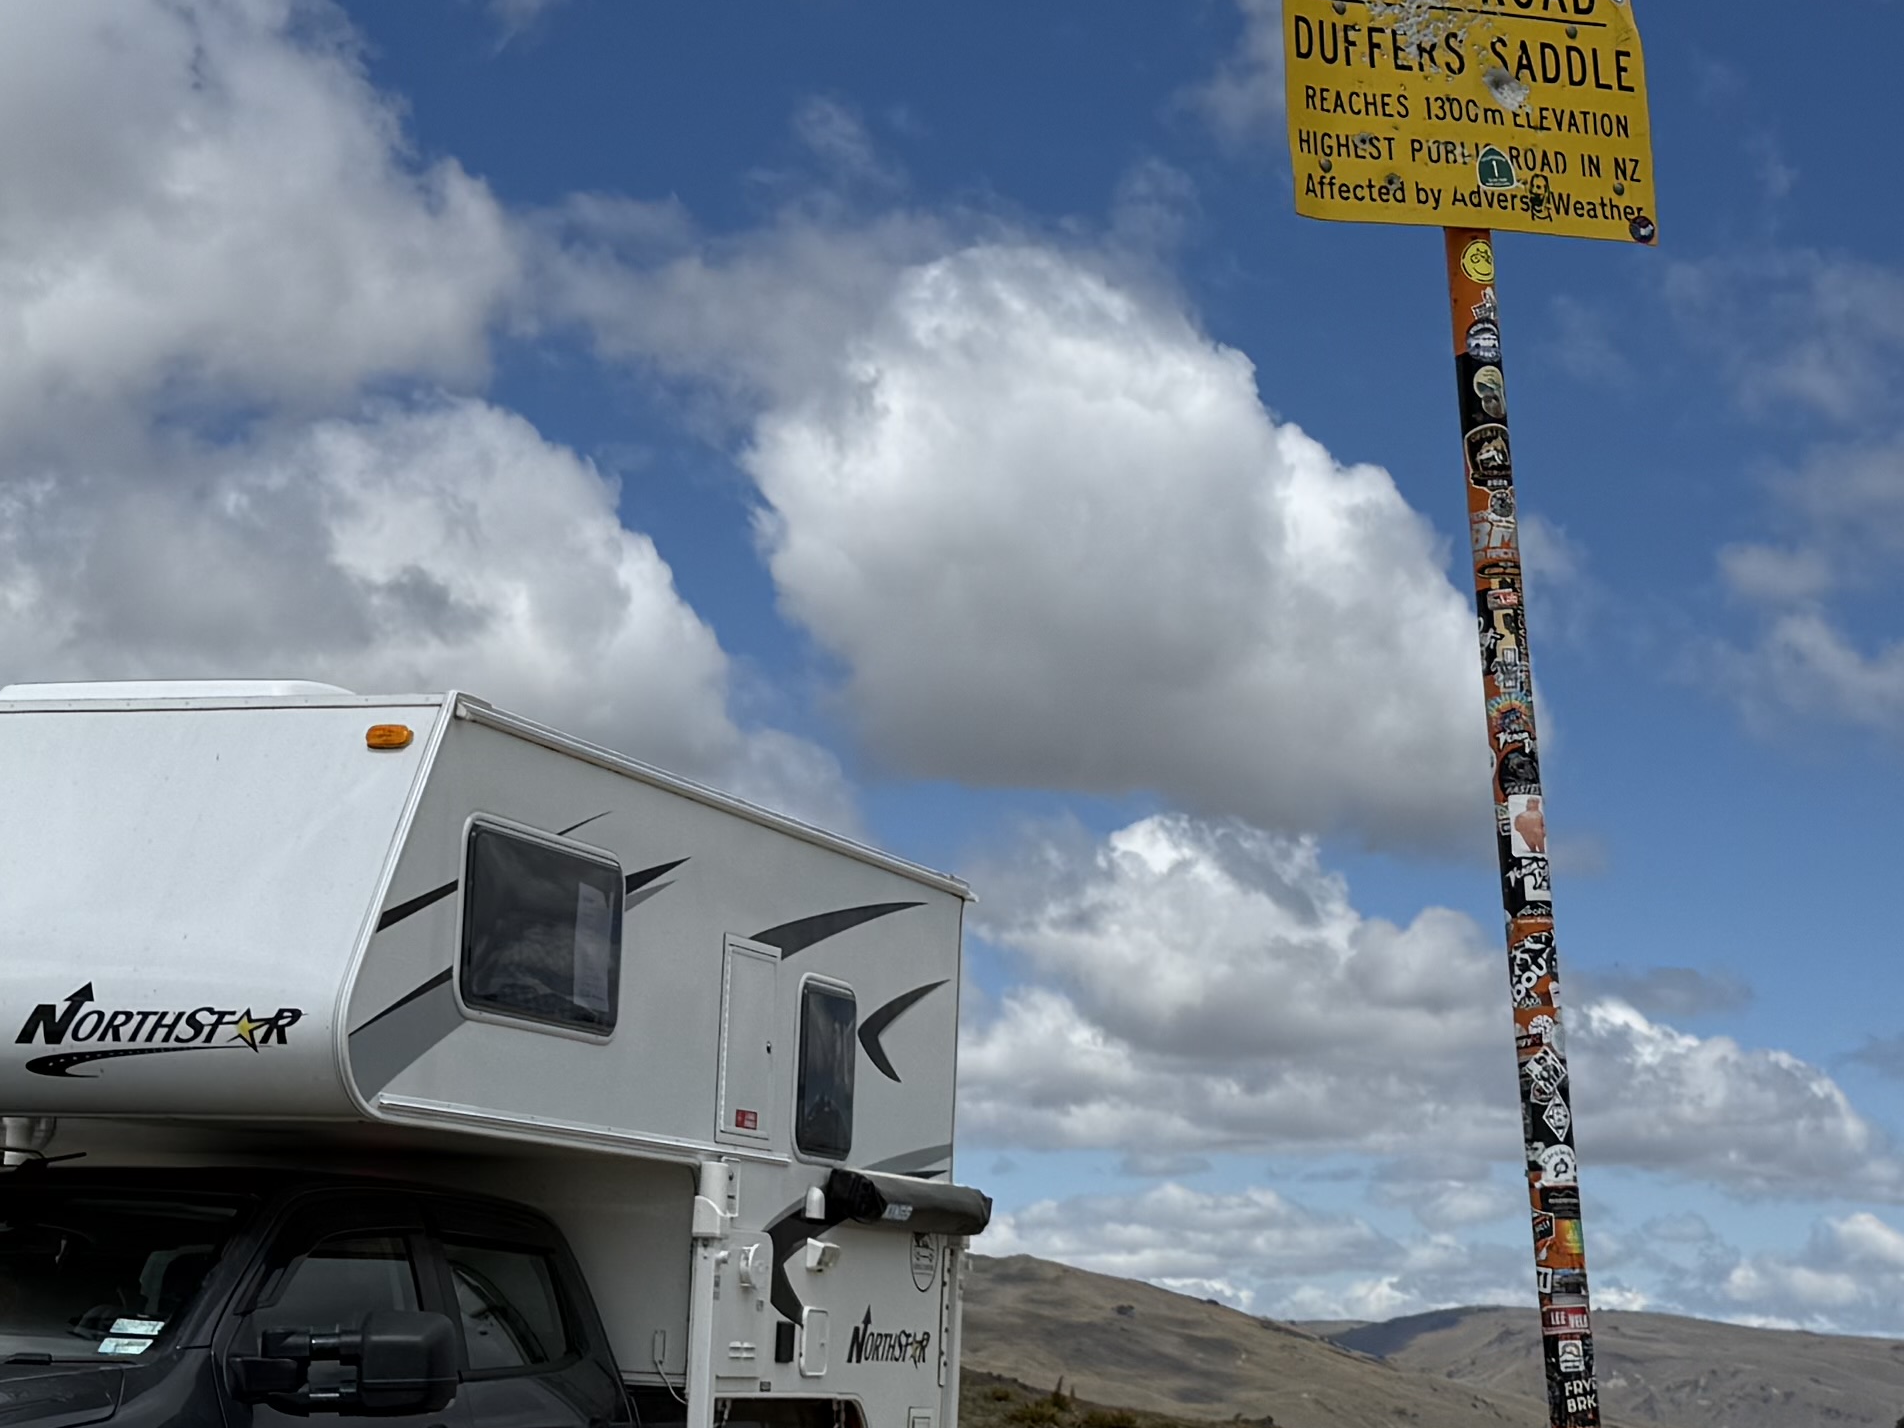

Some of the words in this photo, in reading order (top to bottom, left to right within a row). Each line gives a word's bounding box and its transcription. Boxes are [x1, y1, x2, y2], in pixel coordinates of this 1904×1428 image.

[1294, 15, 1465, 75] DUFFERS
[1491, 36, 1635, 92] SADDLE
[1305, 85, 1409, 118] REACHES
[1424, 96, 1504, 126] 1300m
[1512, 107, 1630, 138] ELEVATION
[1299, 128, 1395, 161] HIGHEST
[1411, 138, 1493, 165] PUBLI
[1508, 146, 1568, 174] ROAD
[1581, 153, 1601, 178] IN
[1614, 157, 1641, 182] NZ
[1305, 173, 1406, 204] Affected
[1415, 181, 1442, 210] by
[1551, 191, 1644, 222] Weather
